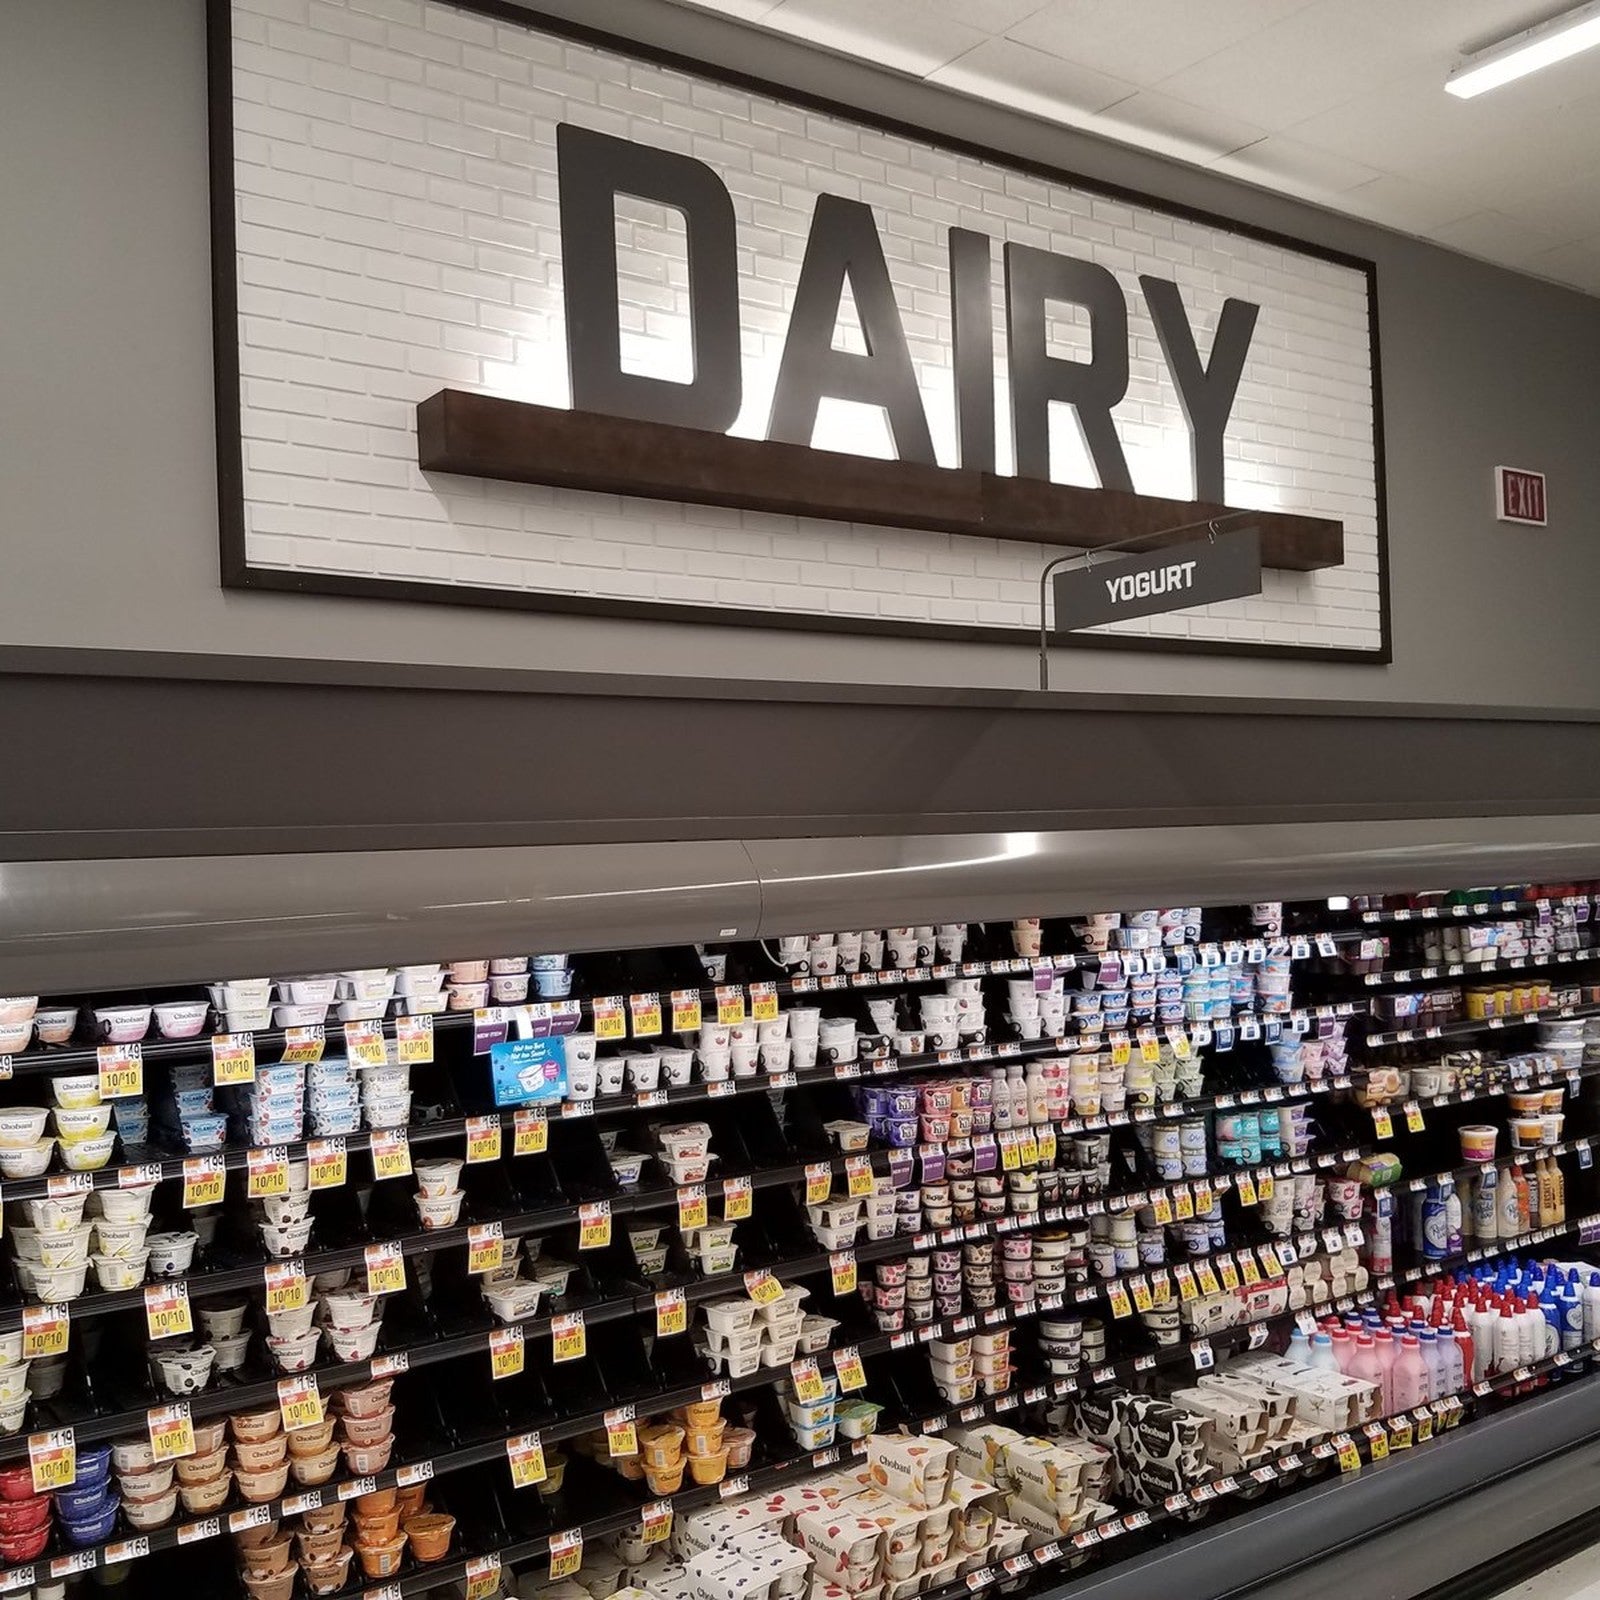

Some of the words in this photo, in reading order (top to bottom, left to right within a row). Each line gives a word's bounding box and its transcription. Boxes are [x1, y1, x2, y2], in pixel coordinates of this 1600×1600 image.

[556, 122, 1260, 504] DAIRY
[1506, 474, 1541, 517] EXIT
[1106, 561, 1197, 603] YOGURT
[221, 1060, 250, 1075] 10/$10
[62, 1082, 93, 1091] Chobani
[106, 1072, 137, 1087] 10/$10
[61, 1114, 91, 1123] Chobani
[315, 1164, 341, 1179] 10/$10
[191, 1182, 220, 1197] 10/$10
[256, 1174, 284, 1188] 10/$10
[155, 1311, 185, 1326] 10/$10
[31, 1333, 62, 1348] 10/$10
[289, 1402, 316, 1418] 10/$10
[1082, 1400, 1110, 1420] Chobani
[51, 1429, 73, 1446] $1.19
[159, 1431, 188, 1448] 10/$10
[1140, 1422, 1170, 1442] Chobani
[40, 1460, 70, 1479] 10/$10
[879, 1455, 912, 1476] Chobani
[1015, 1466, 1044, 1486] Chobani
[1141, 1471, 1173, 1491] Chobani
[1021, 1515, 1055, 1537] Chobani
[808, 1535, 837, 1558] Chobani
